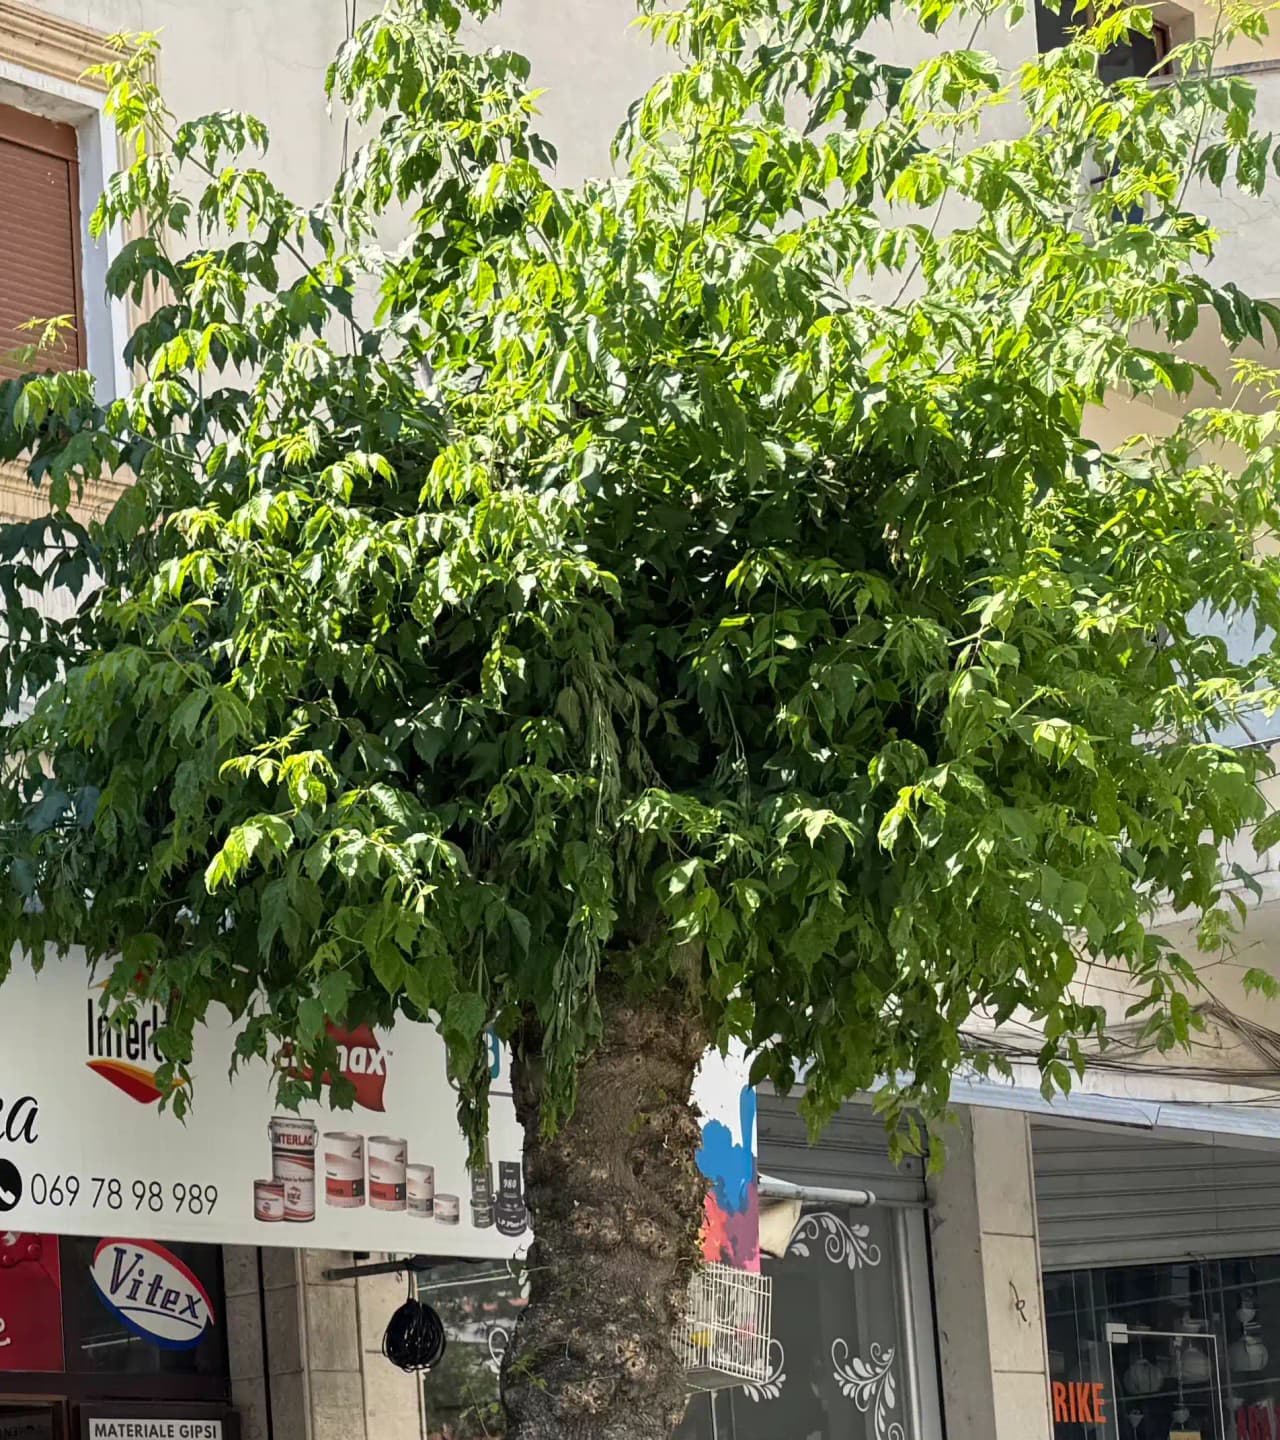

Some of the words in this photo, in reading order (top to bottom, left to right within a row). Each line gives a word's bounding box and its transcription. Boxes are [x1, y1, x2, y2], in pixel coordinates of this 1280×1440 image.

[31, 1174, 80, 1208] 069
[91, 1177, 122, 1210] 78
[131, 1180, 164, 1212] 98
[173, 1183, 219, 1215] 989
[109, 1246, 205, 1322] Vitex
[1052, 1380, 1107, 1424] RIKE
[95, 1424, 175, 1438] MATERIALE
[179, 1425, 217, 1439] GIPSI
